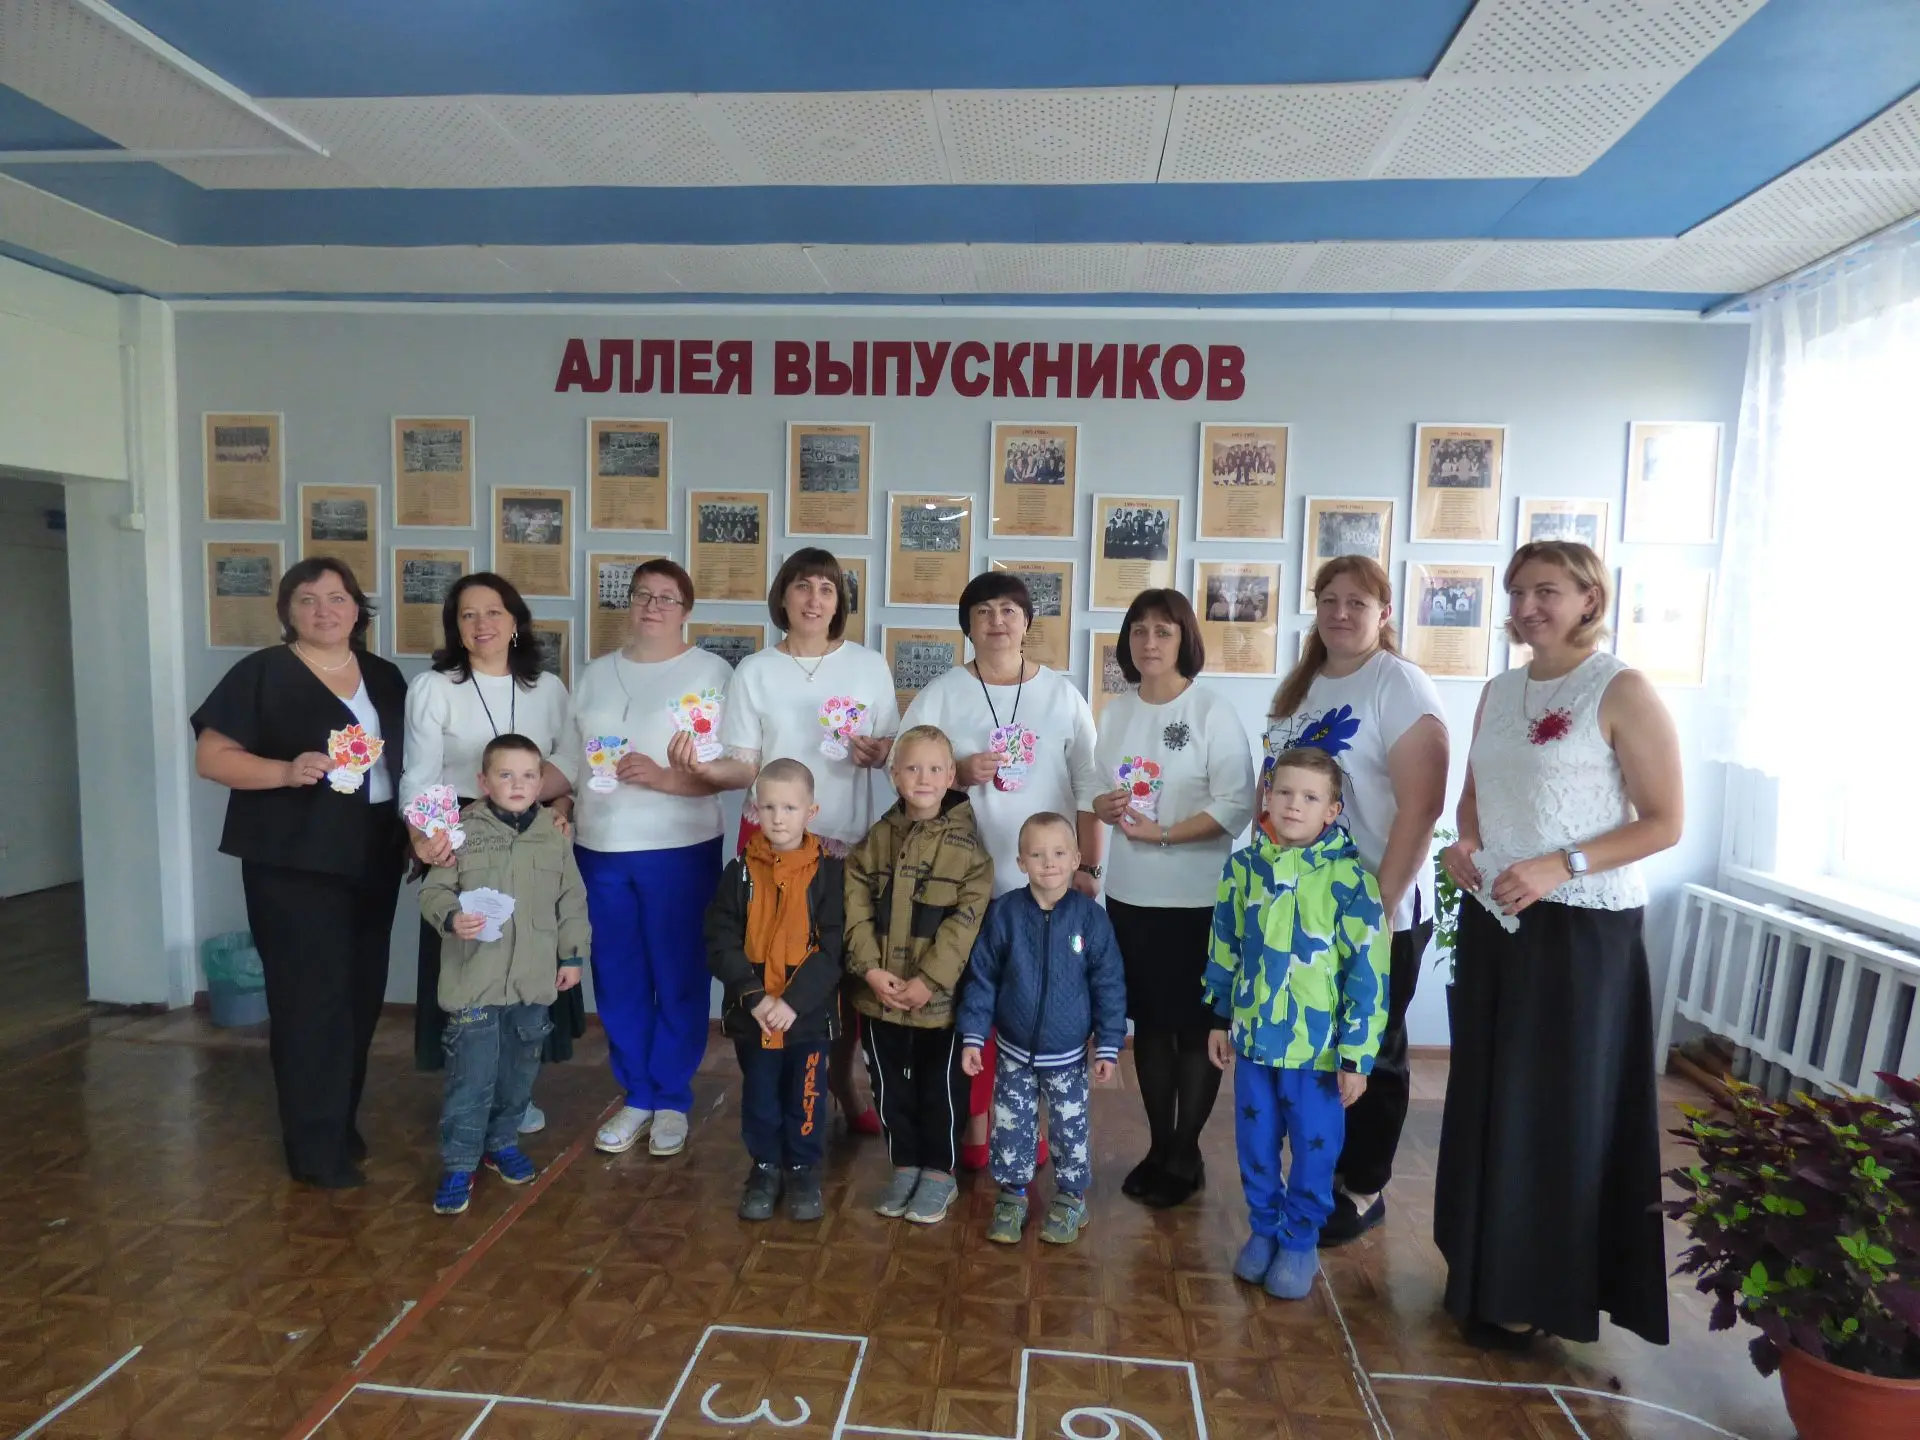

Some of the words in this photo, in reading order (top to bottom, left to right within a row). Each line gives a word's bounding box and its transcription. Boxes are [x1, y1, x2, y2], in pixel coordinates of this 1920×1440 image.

[555, 338, 753, 394] АЛЛЕЯ
[774, 341, 1246, 400] ВЫПУСКНИКОВ
[800, 1051, 820, 1136] NARUTO
[700, 1383, 811, 1427] 3
